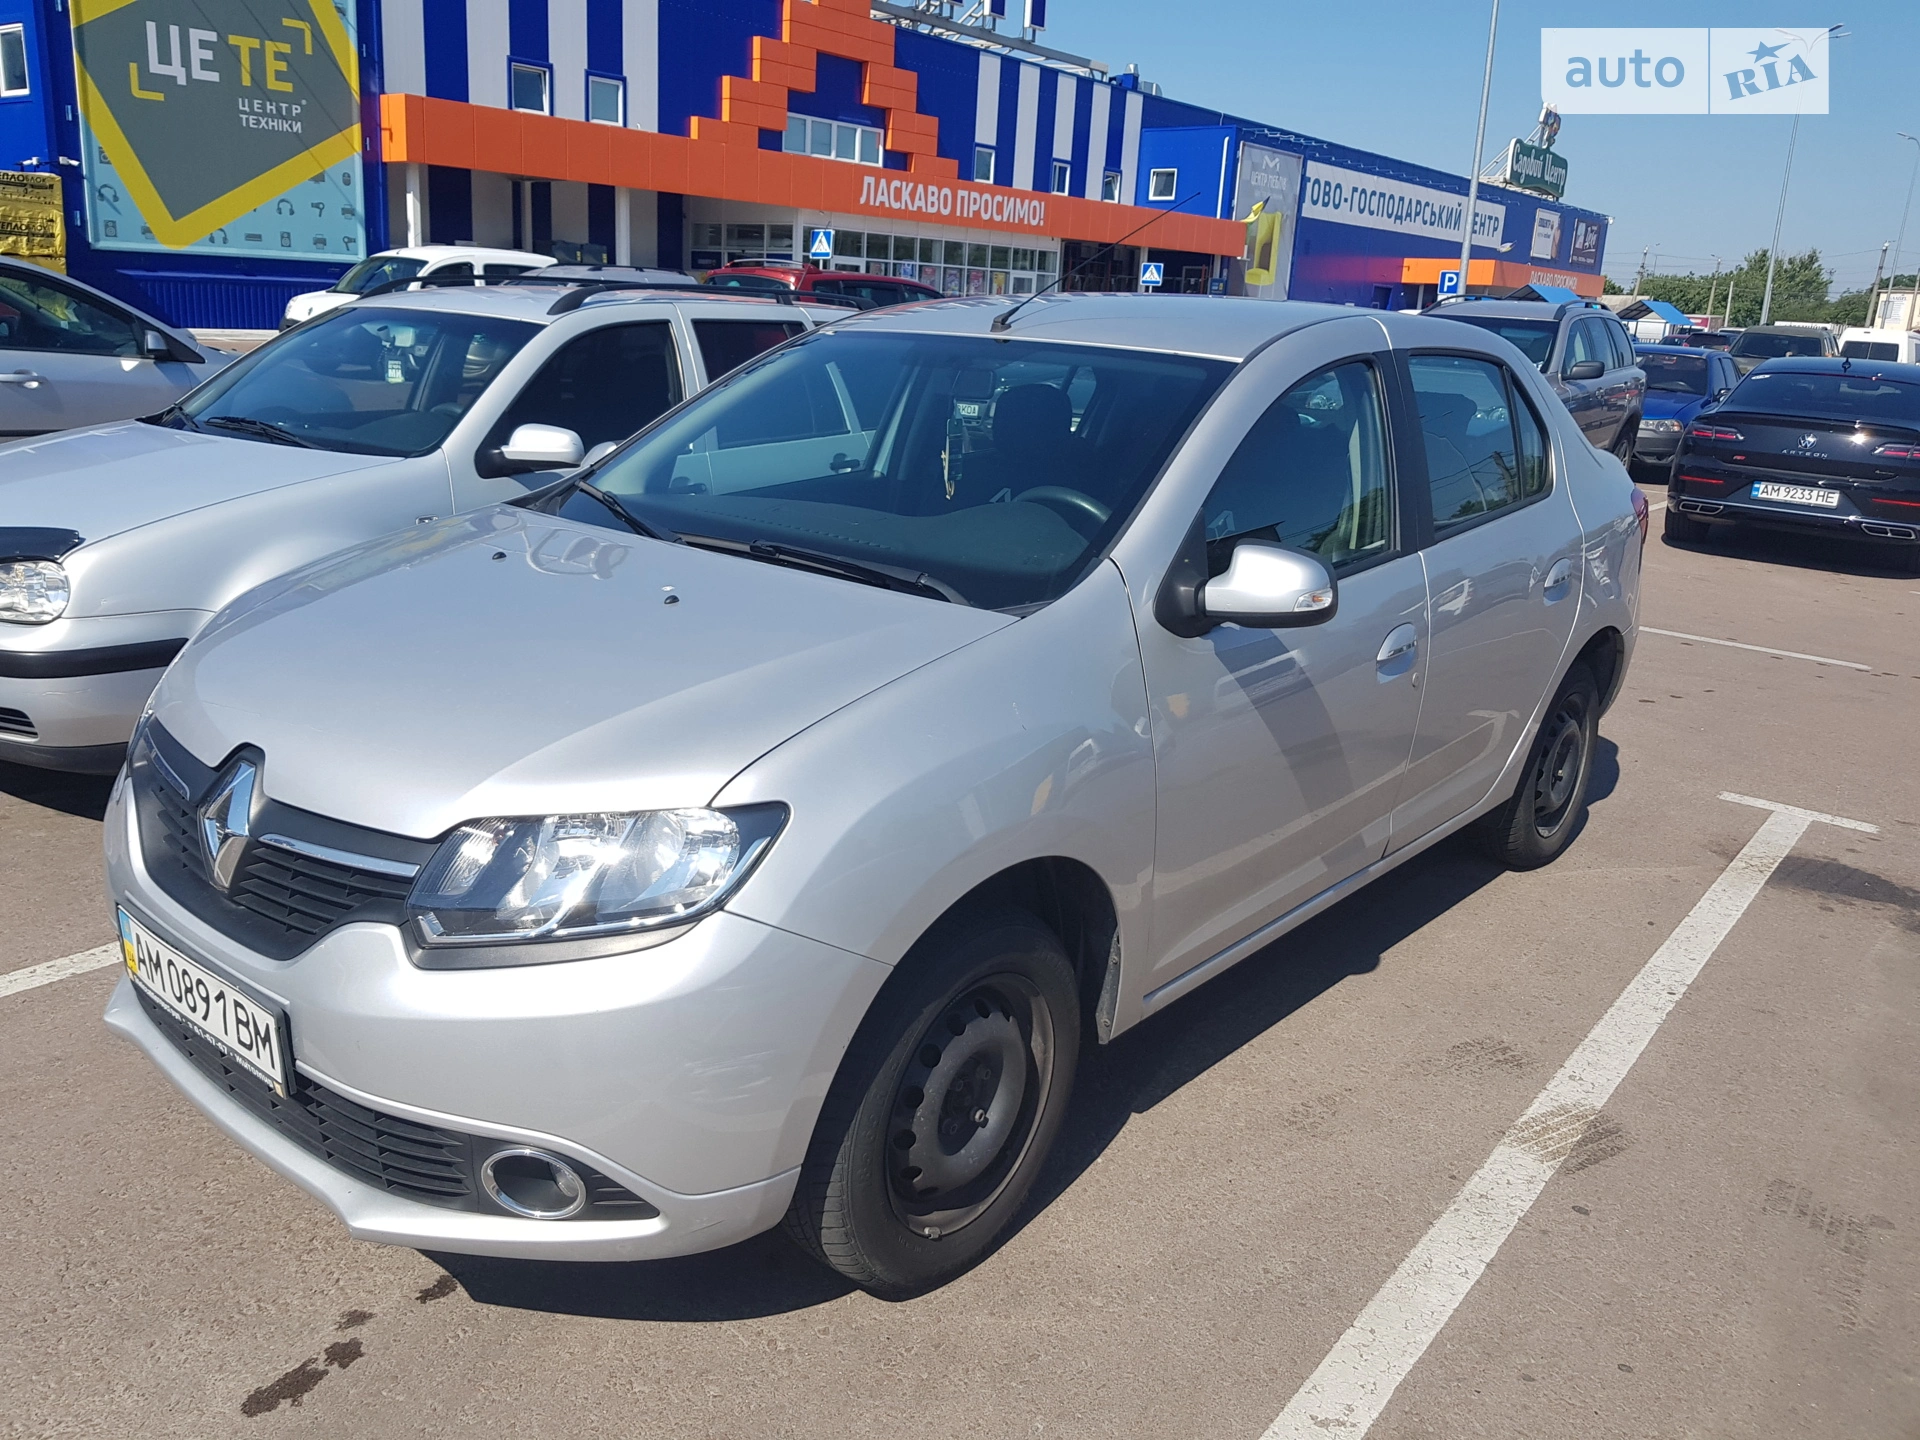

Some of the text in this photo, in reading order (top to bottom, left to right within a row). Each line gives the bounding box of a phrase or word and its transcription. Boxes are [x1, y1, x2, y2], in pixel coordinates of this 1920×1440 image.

[238, 97, 302, 117] ЦЕНТР
[239, 113, 302, 134] ТЕХНІКИ
[859, 175, 1045, 227] ЛАСКАВО ПРОСИМО!
[1472, 211, 1500, 238] ЕНТР
[1443, 273, 1457, 292] P
[1781, 449, 1828, 459] ARTEON
[1760, 484, 1781, 497] AM
[1783, 486, 1814, 501] 9233
[1815, 490, 1836, 504] HE
